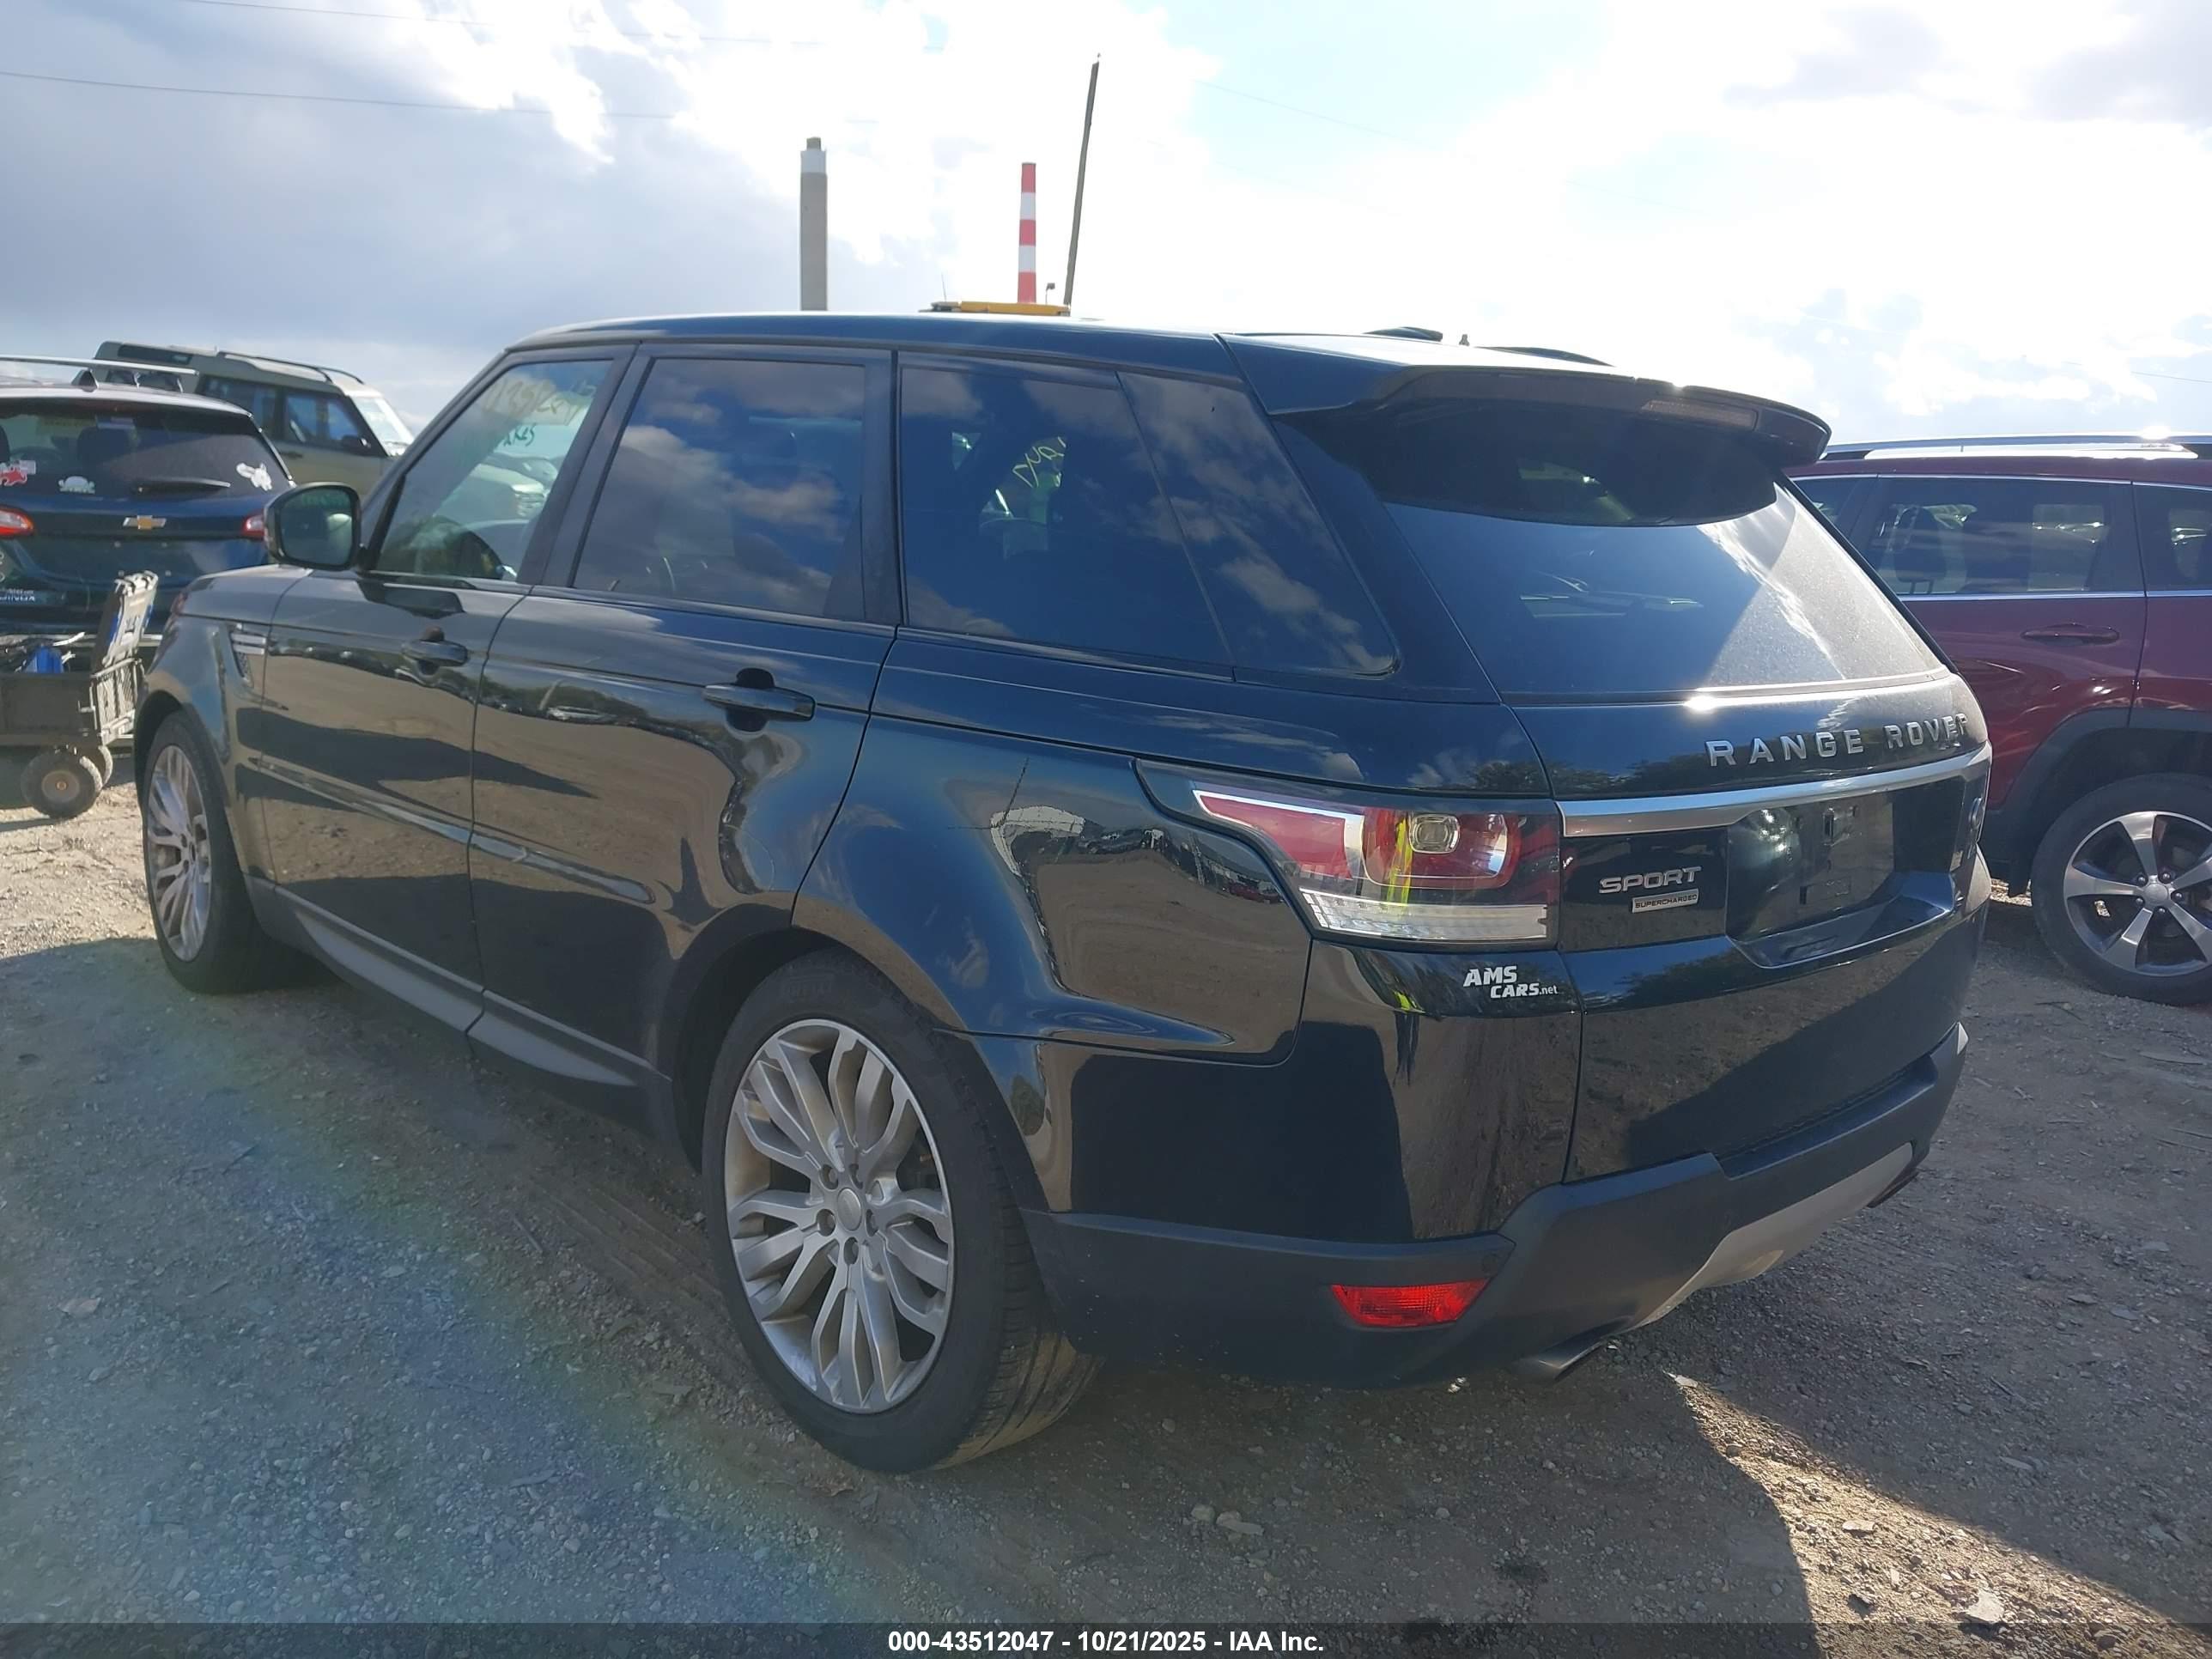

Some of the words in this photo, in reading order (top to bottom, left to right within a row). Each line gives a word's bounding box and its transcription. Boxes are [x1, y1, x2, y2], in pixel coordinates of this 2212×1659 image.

[1706, 728, 1863, 767] RANGE
[1884, 713, 1969, 750] ROVER
[1599, 866, 1702, 894] SPORT
[1635, 894, 1698, 908] SUPERCHARGED
[1462, 965, 1517, 988] AMS
[1490, 982, 1559, 999] CARS.net
